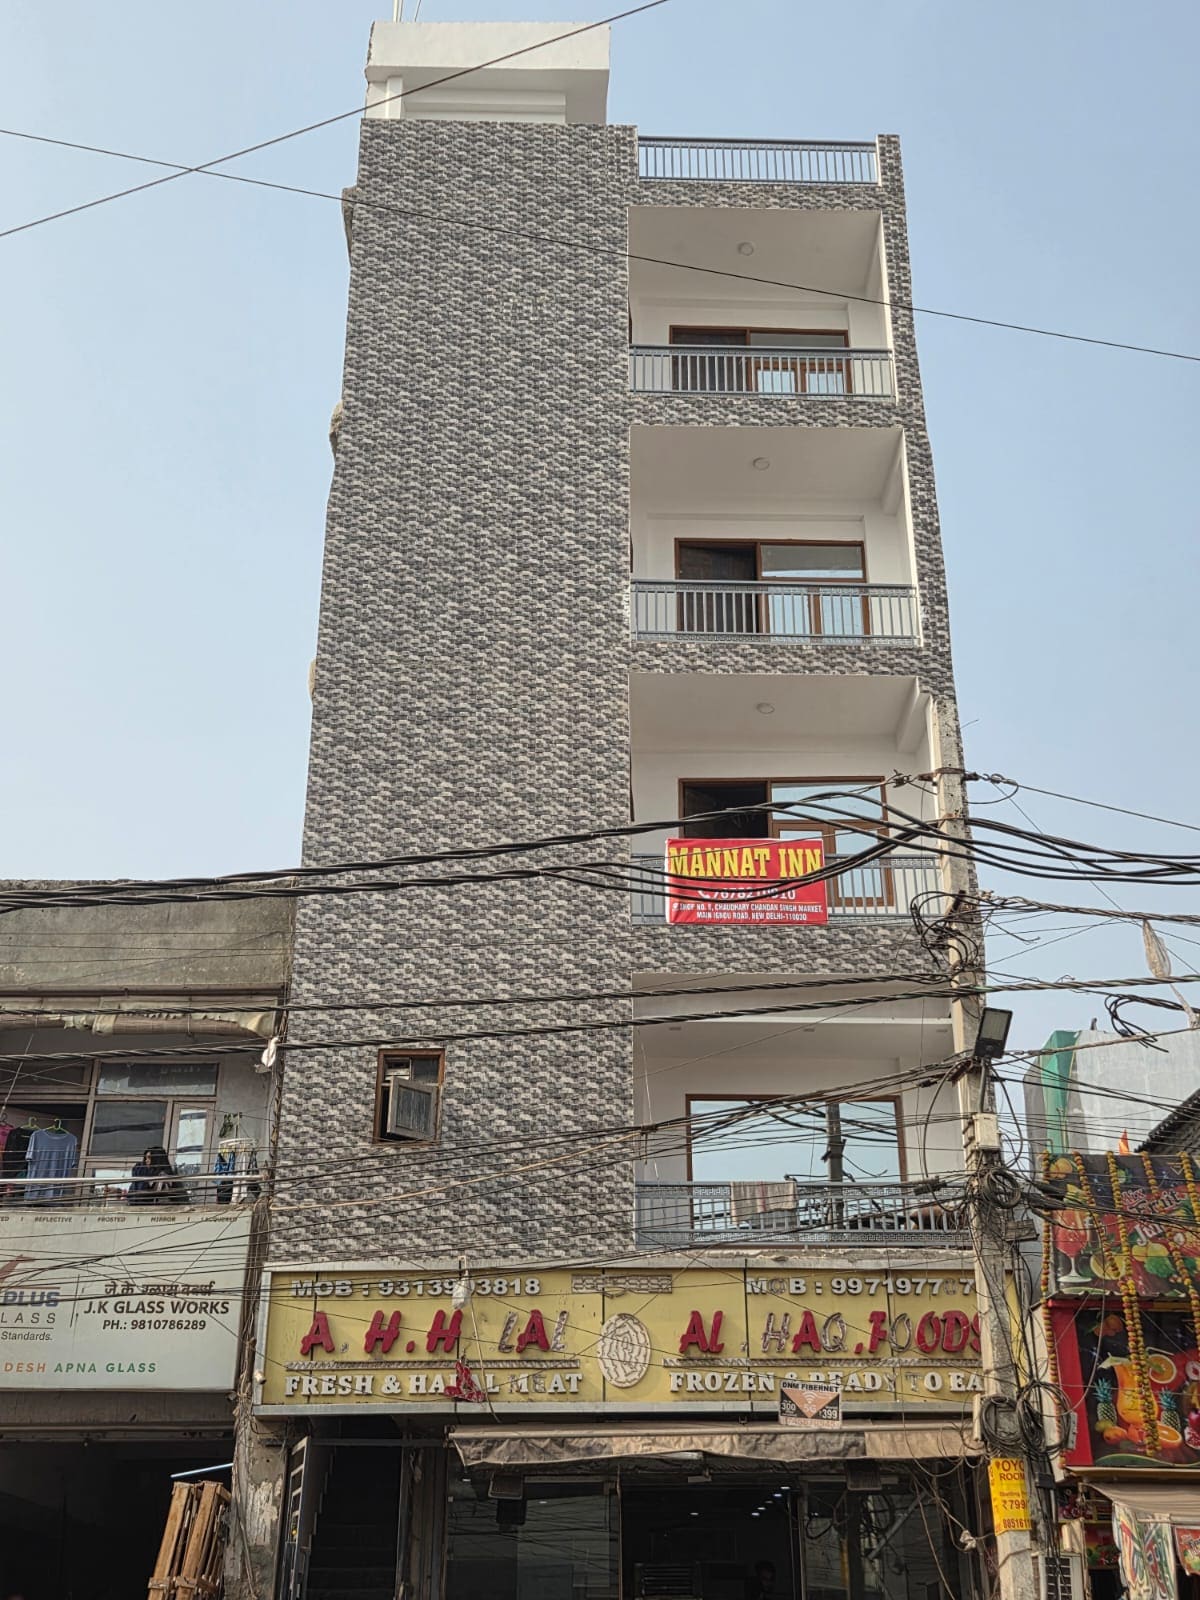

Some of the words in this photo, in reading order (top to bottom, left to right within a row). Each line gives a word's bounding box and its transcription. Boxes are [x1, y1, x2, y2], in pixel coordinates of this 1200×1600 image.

[669, 847, 771, 878] MANNAT
[778, 848, 821, 878] INN
[291, 1280, 352, 1296] MOB
[3, 1291, 60, 1307] PLUS
[84, 1301, 109, 1314] J.K
[113, 1301, 165, 1314] GLASS
[171, 1301, 230, 1314] WORKS
[130, 1319, 207, 1331] 9810786289
[0, 1331, 53, 1341] Standards.
[4, 1362, 46, 1373] DESH
[54, 1362, 97, 1373] APNA
[105, 1362, 157, 1373] GLASS
[284, 1375, 374, 1396] FRESH
[381, 1375, 402, 1396] &
[669, 1371, 776, 1393] FROZEN
[948, 1371, 984, 1392] EA
[801, 1383, 840, 1393] FIBERNET
